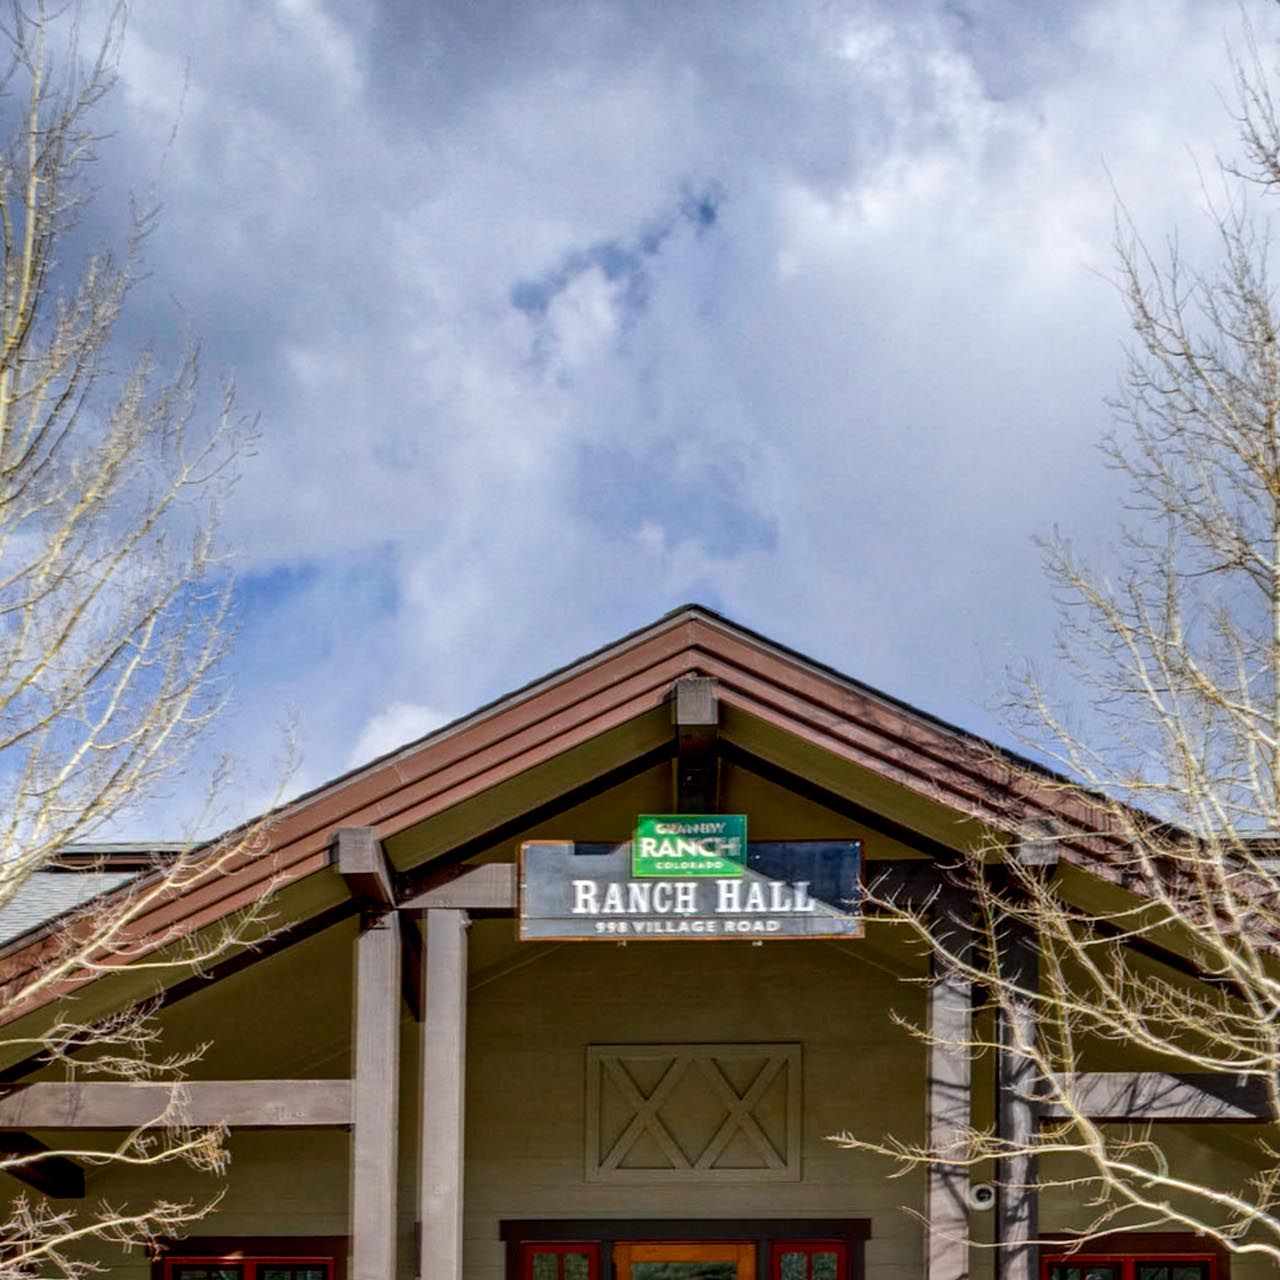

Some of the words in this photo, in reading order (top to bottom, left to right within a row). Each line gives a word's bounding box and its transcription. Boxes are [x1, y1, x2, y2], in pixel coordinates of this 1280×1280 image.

[641, 837, 741, 858] RANCH
[655, 862, 724, 870] COLORADO
[572, 878, 697, 914] RANCH
[714, 878, 816, 913] HALL
[633, 920, 717, 933] VILLAGE
[725, 919, 781, 932] ROAD
